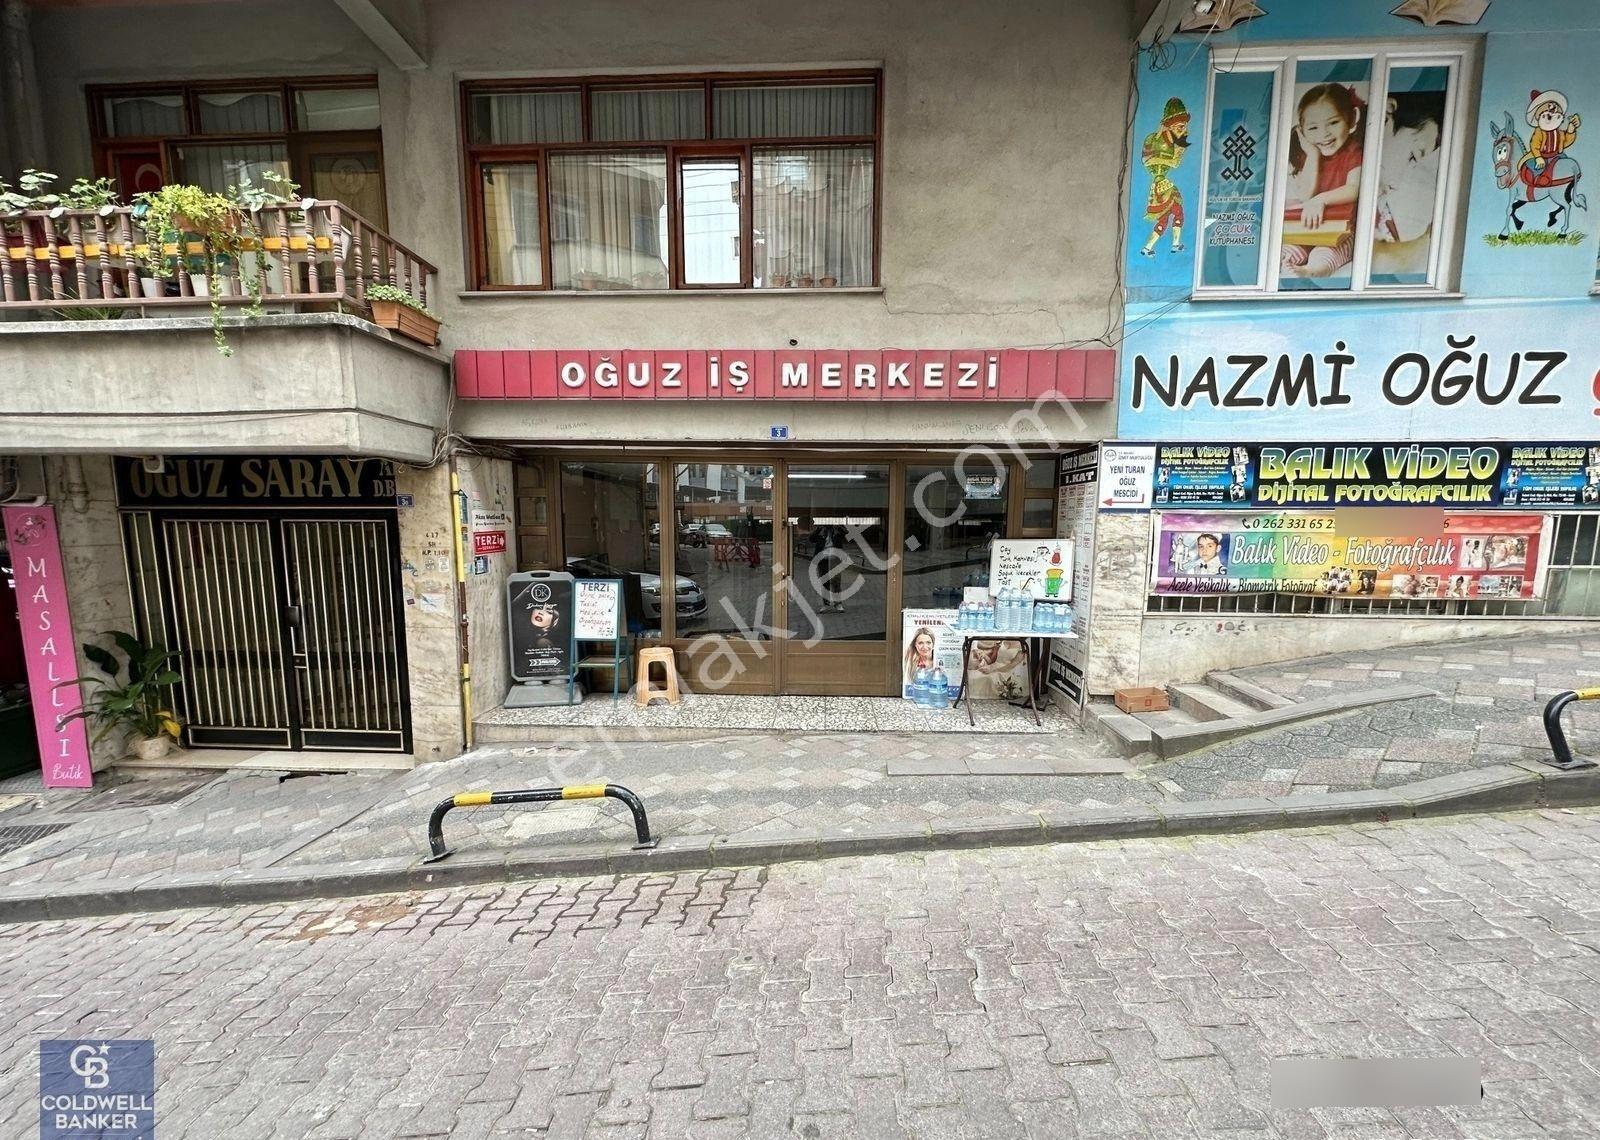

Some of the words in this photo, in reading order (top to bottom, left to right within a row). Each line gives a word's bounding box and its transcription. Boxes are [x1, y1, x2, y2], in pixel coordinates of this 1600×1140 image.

[1215, 224, 1251, 235] ÇOCUK
[561, 356, 682, 388] OĞUZ
[710, 356, 750, 393] İŞ
[781, 356, 998, 389] MERKEZİ
[1132, 341, 1355, 408] NAZMİ
[1381, 335, 1568, 406] OĞUZ
[1161, 446, 1194, 460] BALIK
[1196, 445, 1231, 458] VİDEO
[1511, 447, 1548, 460] BALIK
[1549, 446, 1586, 459] VİDEO
[1110, 464, 1124, 474] YENİ
[1125, 465, 1145, 474] TURAN
[1259, 447, 1373, 482] BALIK
[1383, 443, 1499, 480] VİDEO
[242, 458, 364, 497] SARAY
[1119, 476, 1136, 486] OĞUZ
[1113, 488, 1138, 498] MESCİDİ
[1258, 482, 1329, 505] DİJİTAL
[1252, 518, 1260, 529] 0
[1264, 518, 1284, 529] 262
[1286, 518, 1306, 529] 331
[1309, 518, 1323, 529] 65
[1232, 536, 1277, 564] Balık
[1282, 535, 1329, 565] Video
[1344, 536, 1455, 573] Fotoğrafçılık
[1168, 578, 1191, 593] Acele
[1194, 578, 1231, 593] Vesikalık
[52, 763, 85, 781] Butik
